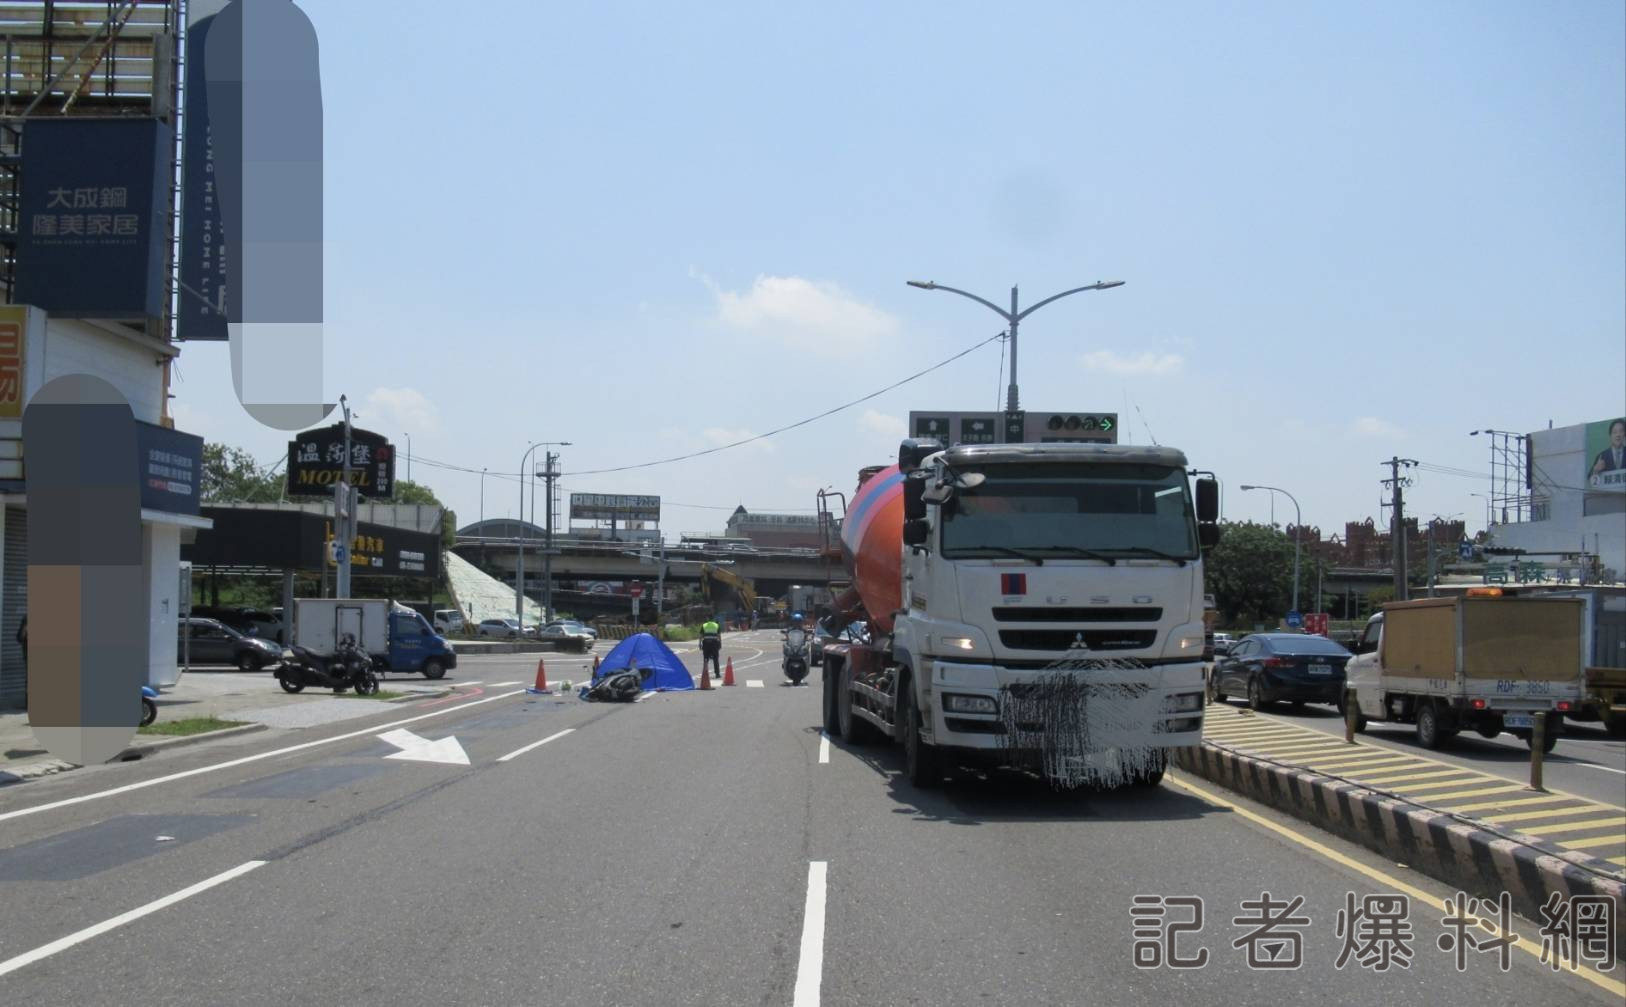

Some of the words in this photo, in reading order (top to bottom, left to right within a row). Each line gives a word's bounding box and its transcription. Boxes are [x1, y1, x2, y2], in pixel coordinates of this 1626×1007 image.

[47, 186, 127, 208] 大成鋼
[32, 214, 138, 236] 隆美家居
[297, 469, 371, 486] MOTEL
